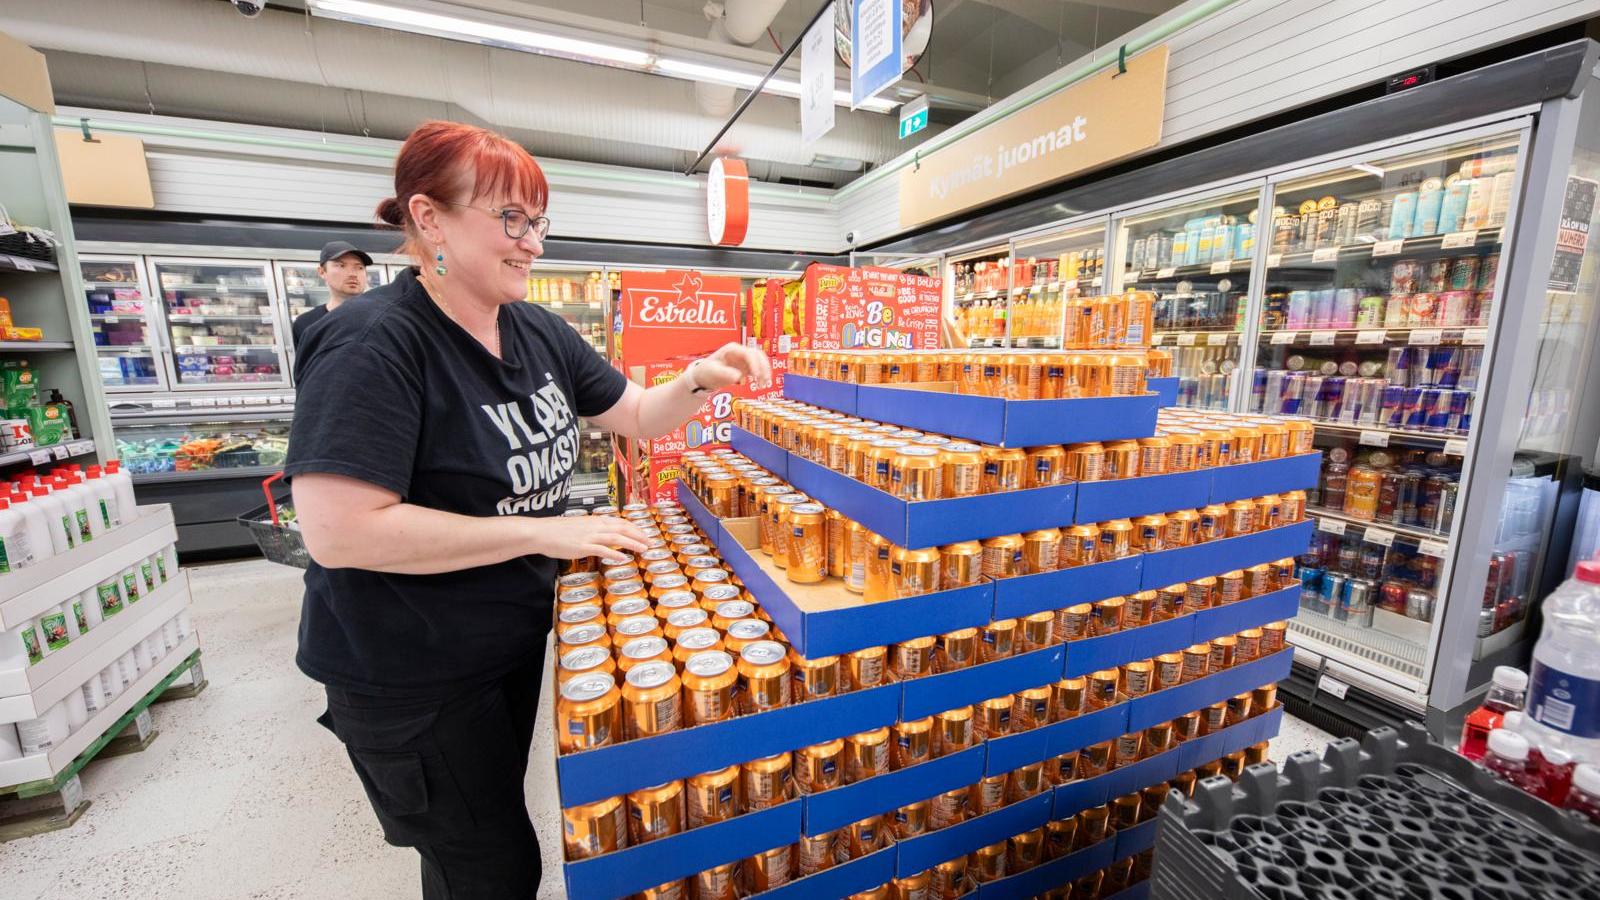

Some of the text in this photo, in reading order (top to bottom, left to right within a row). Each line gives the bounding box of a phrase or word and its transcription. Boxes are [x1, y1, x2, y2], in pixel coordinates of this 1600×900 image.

[930, 115, 1087, 198] Kylmät juomat
[639, 296, 728, 325] Estrella
[867, 300, 895, 325] Be
